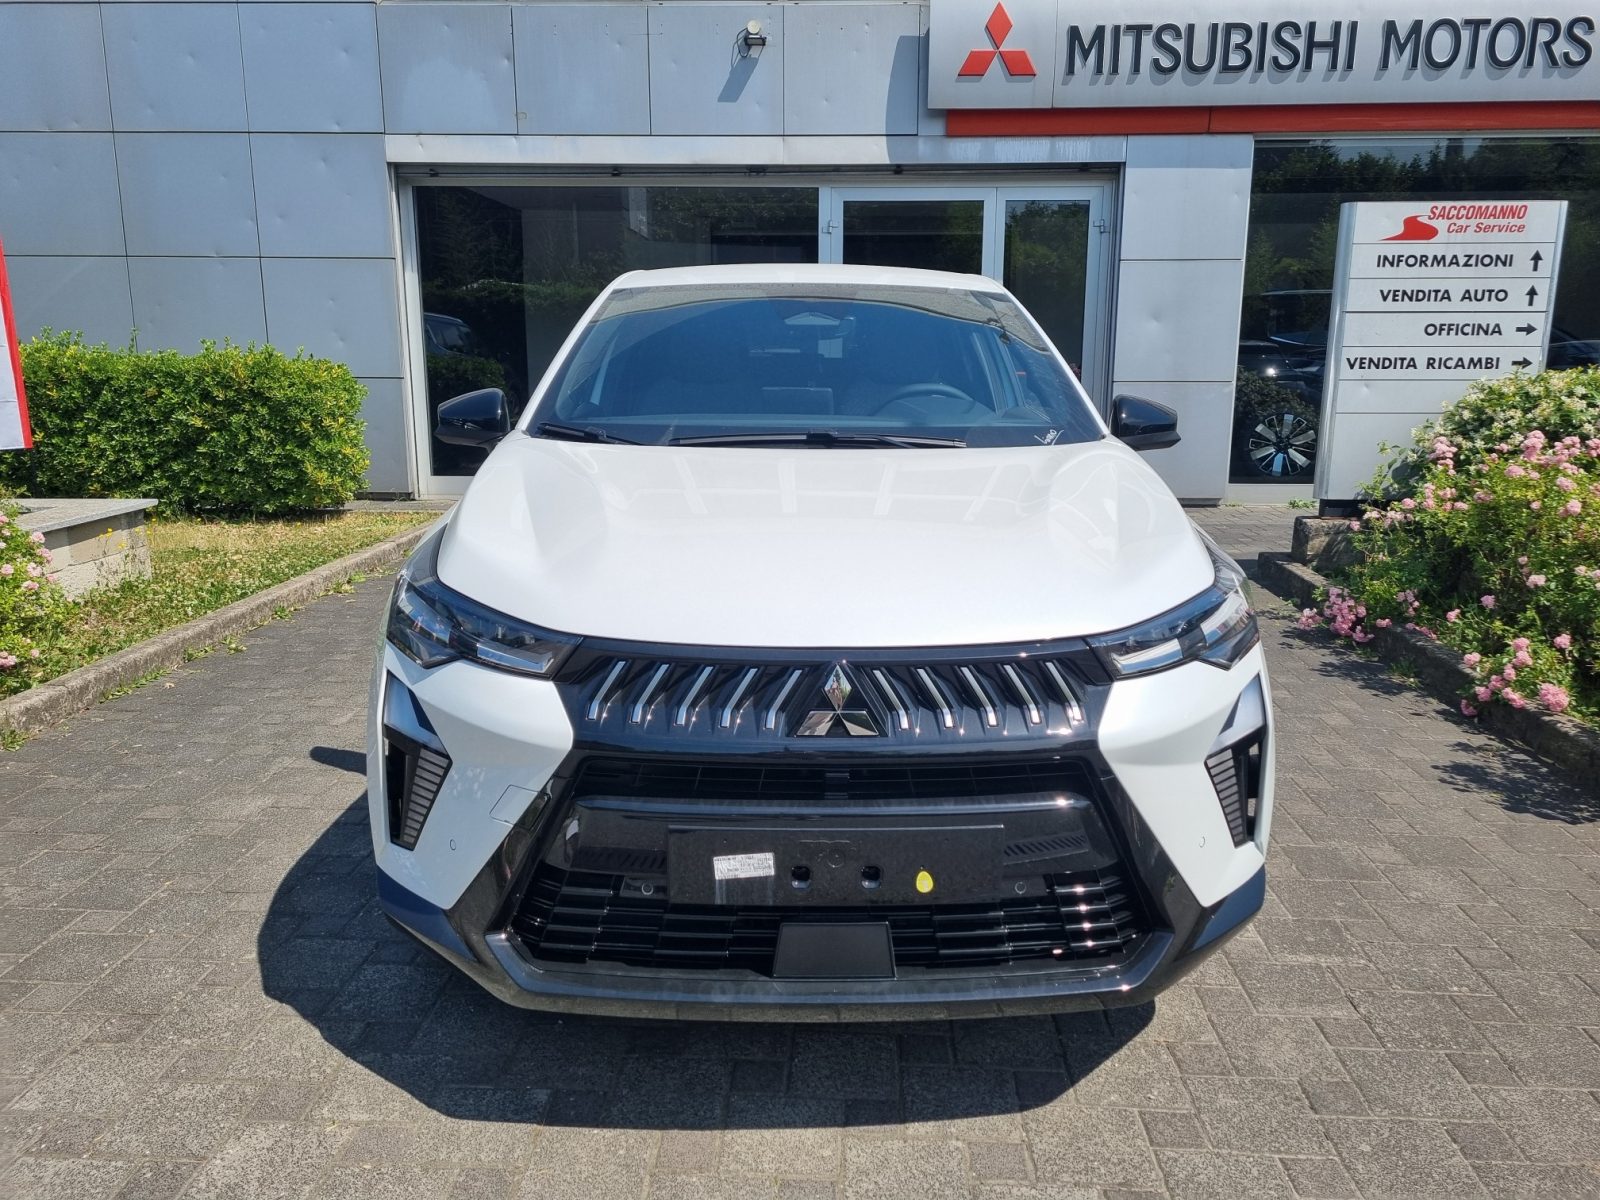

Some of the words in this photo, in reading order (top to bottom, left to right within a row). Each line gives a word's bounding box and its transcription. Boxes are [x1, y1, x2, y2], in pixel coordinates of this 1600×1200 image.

[1066, 20, 1359, 76] MITSUBISHI
[1379, 16, 1595, 71] MOTORS
[1427, 204, 1528, 220] SACCOMANNO
[1446, 222, 1471, 234] Car
[1473, 222, 1526, 233] Service
[1376, 253, 1514, 268] INFORMAZIONI
[1379, 289, 1452, 302] VENDITA
[1460, 288, 1509, 302] AUTO
[1424, 322, 1503, 336] OFFICINA
[1346, 357, 1418, 370] VENDITA
[1426, 356, 1500, 370] RICAMBI
